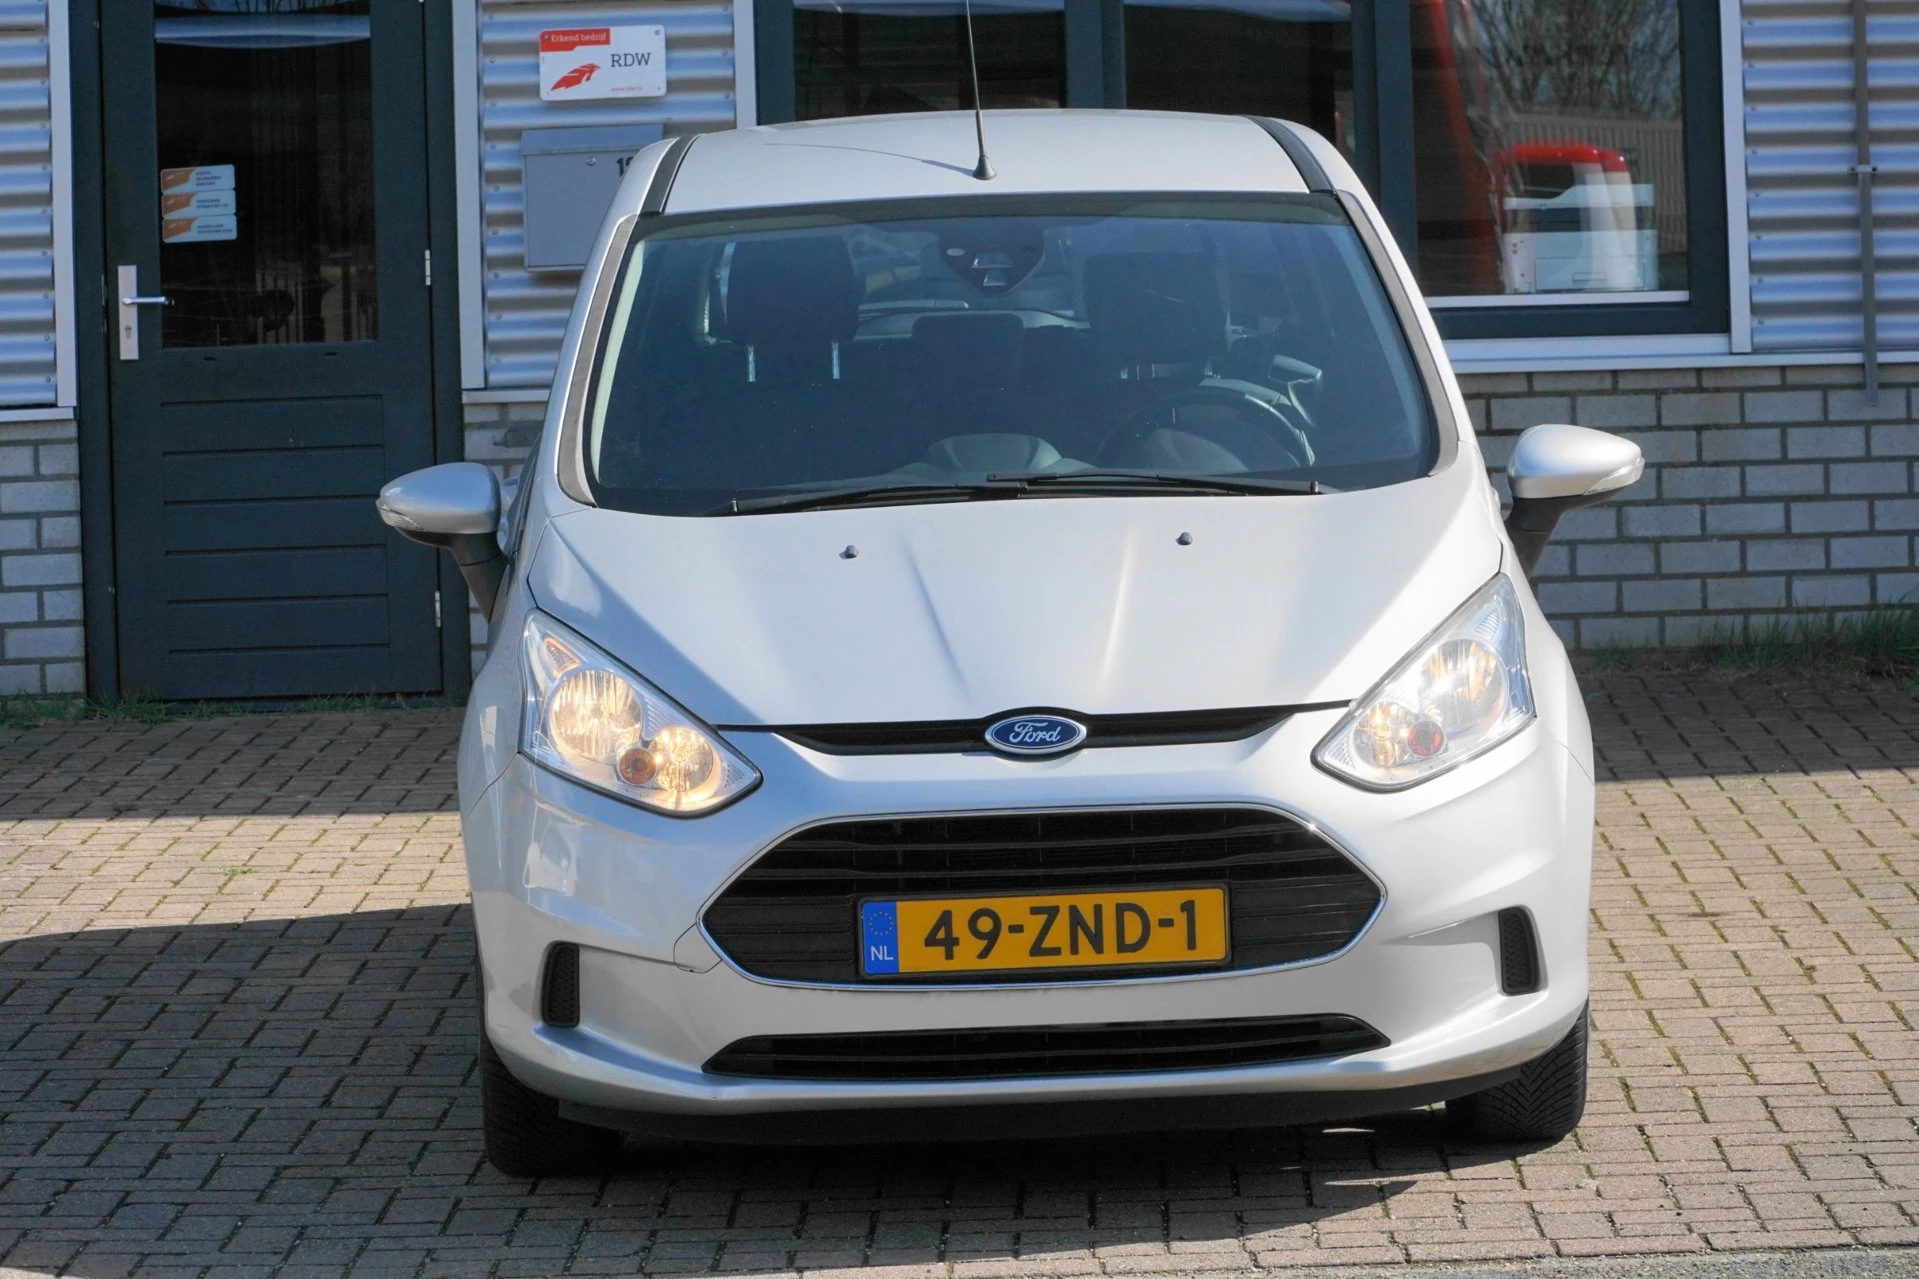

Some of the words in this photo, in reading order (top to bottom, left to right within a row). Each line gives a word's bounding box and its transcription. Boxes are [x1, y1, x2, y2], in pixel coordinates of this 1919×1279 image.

[551, 33, 580, 43] Erkend
[580, 31, 606, 42] bedrijf
[610, 52, 651, 68] RDW
[1009, 722, 1061, 743] Ford
[924, 900, 1197, 961] 49-ZND-1
[870, 945, 894, 961] NL
